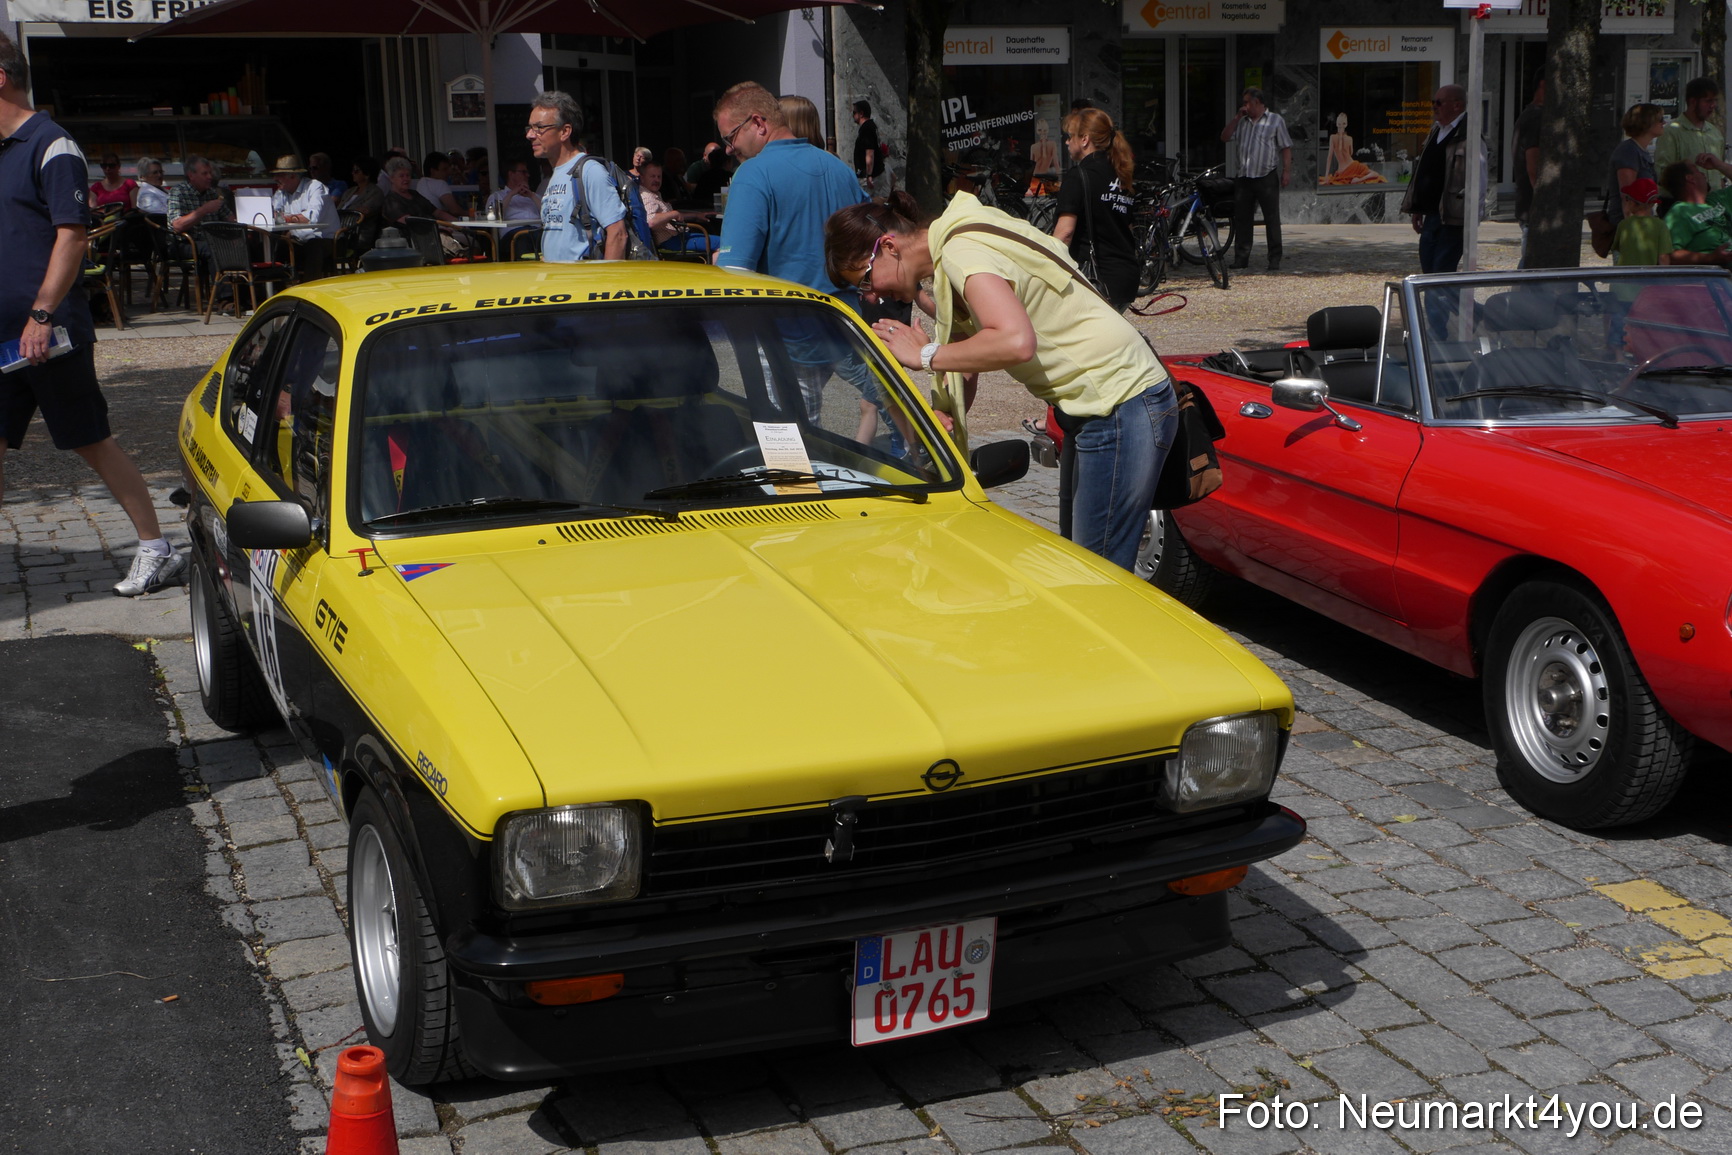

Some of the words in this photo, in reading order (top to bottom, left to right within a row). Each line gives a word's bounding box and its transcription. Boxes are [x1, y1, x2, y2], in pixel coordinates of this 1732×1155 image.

[88, 0, 133, 19] EIS
[1221, 2, 1252, 10] Kosmetik-
[1254, 2, 1267, 10] und
[1221, 12, 1261, 21] Nagelstudio
[943, 36, 994, 55] entral
[1005, 36, 1046, 44] Dauerhafte
[1338, 35, 1391, 54] Central
[1401, 35, 1433, 43] Permanent
[1005, 46, 1060, 55] Haarentfernung
[941, 95, 977, 124] IPL
[364, 302, 458, 327] OPEL
[474, 293, 572, 309] EURO
[587, 287, 833, 303] HÄNDLERTEAM
[315, 598, 349, 655] GT/E
[416, 750, 448, 796] RECARO
[882, 925, 965, 981] LAU
[863, 966, 874, 979] D
[874, 972, 975, 1034] 0765
